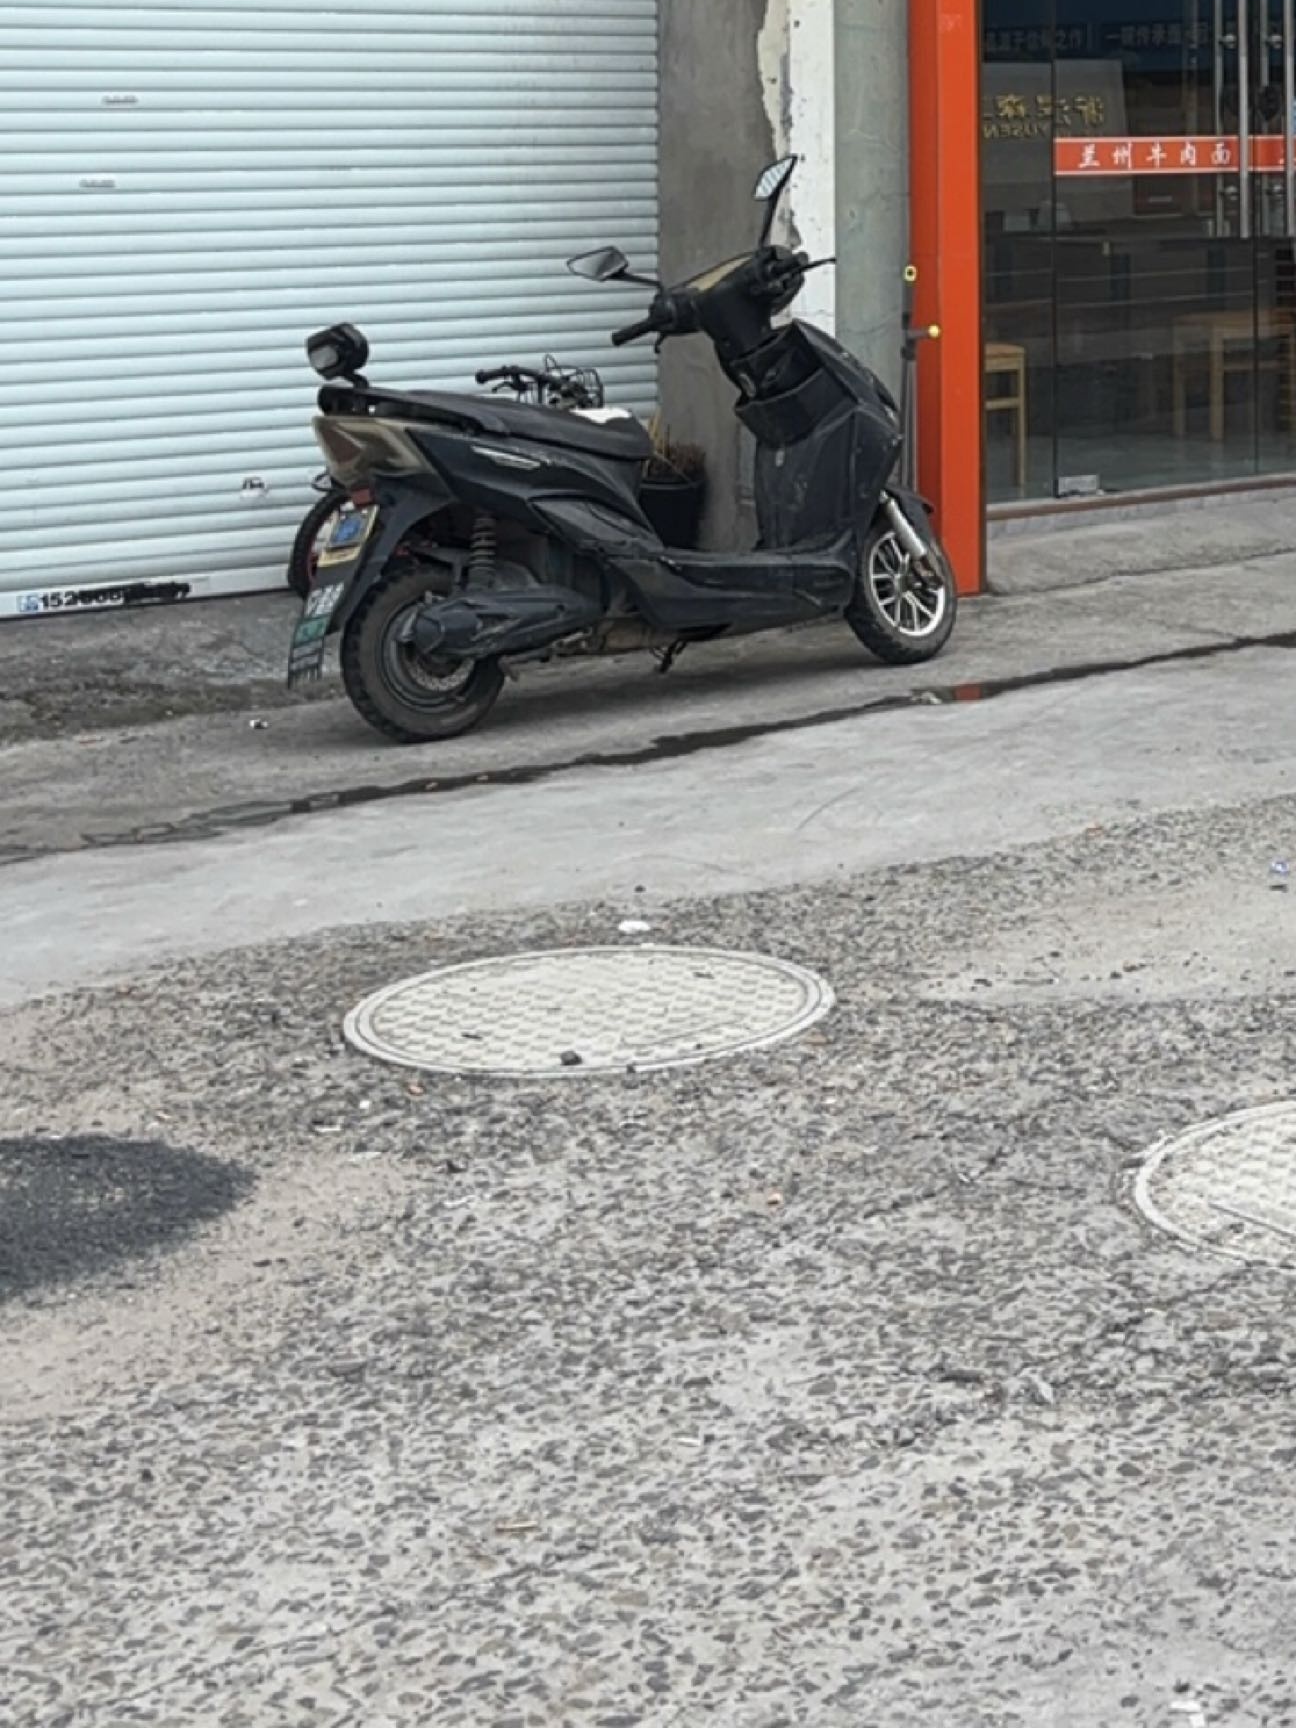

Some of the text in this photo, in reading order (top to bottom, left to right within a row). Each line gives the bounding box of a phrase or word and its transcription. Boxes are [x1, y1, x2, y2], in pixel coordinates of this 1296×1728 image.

[1077, 140, 1232, 169] 兰州牛肉面
